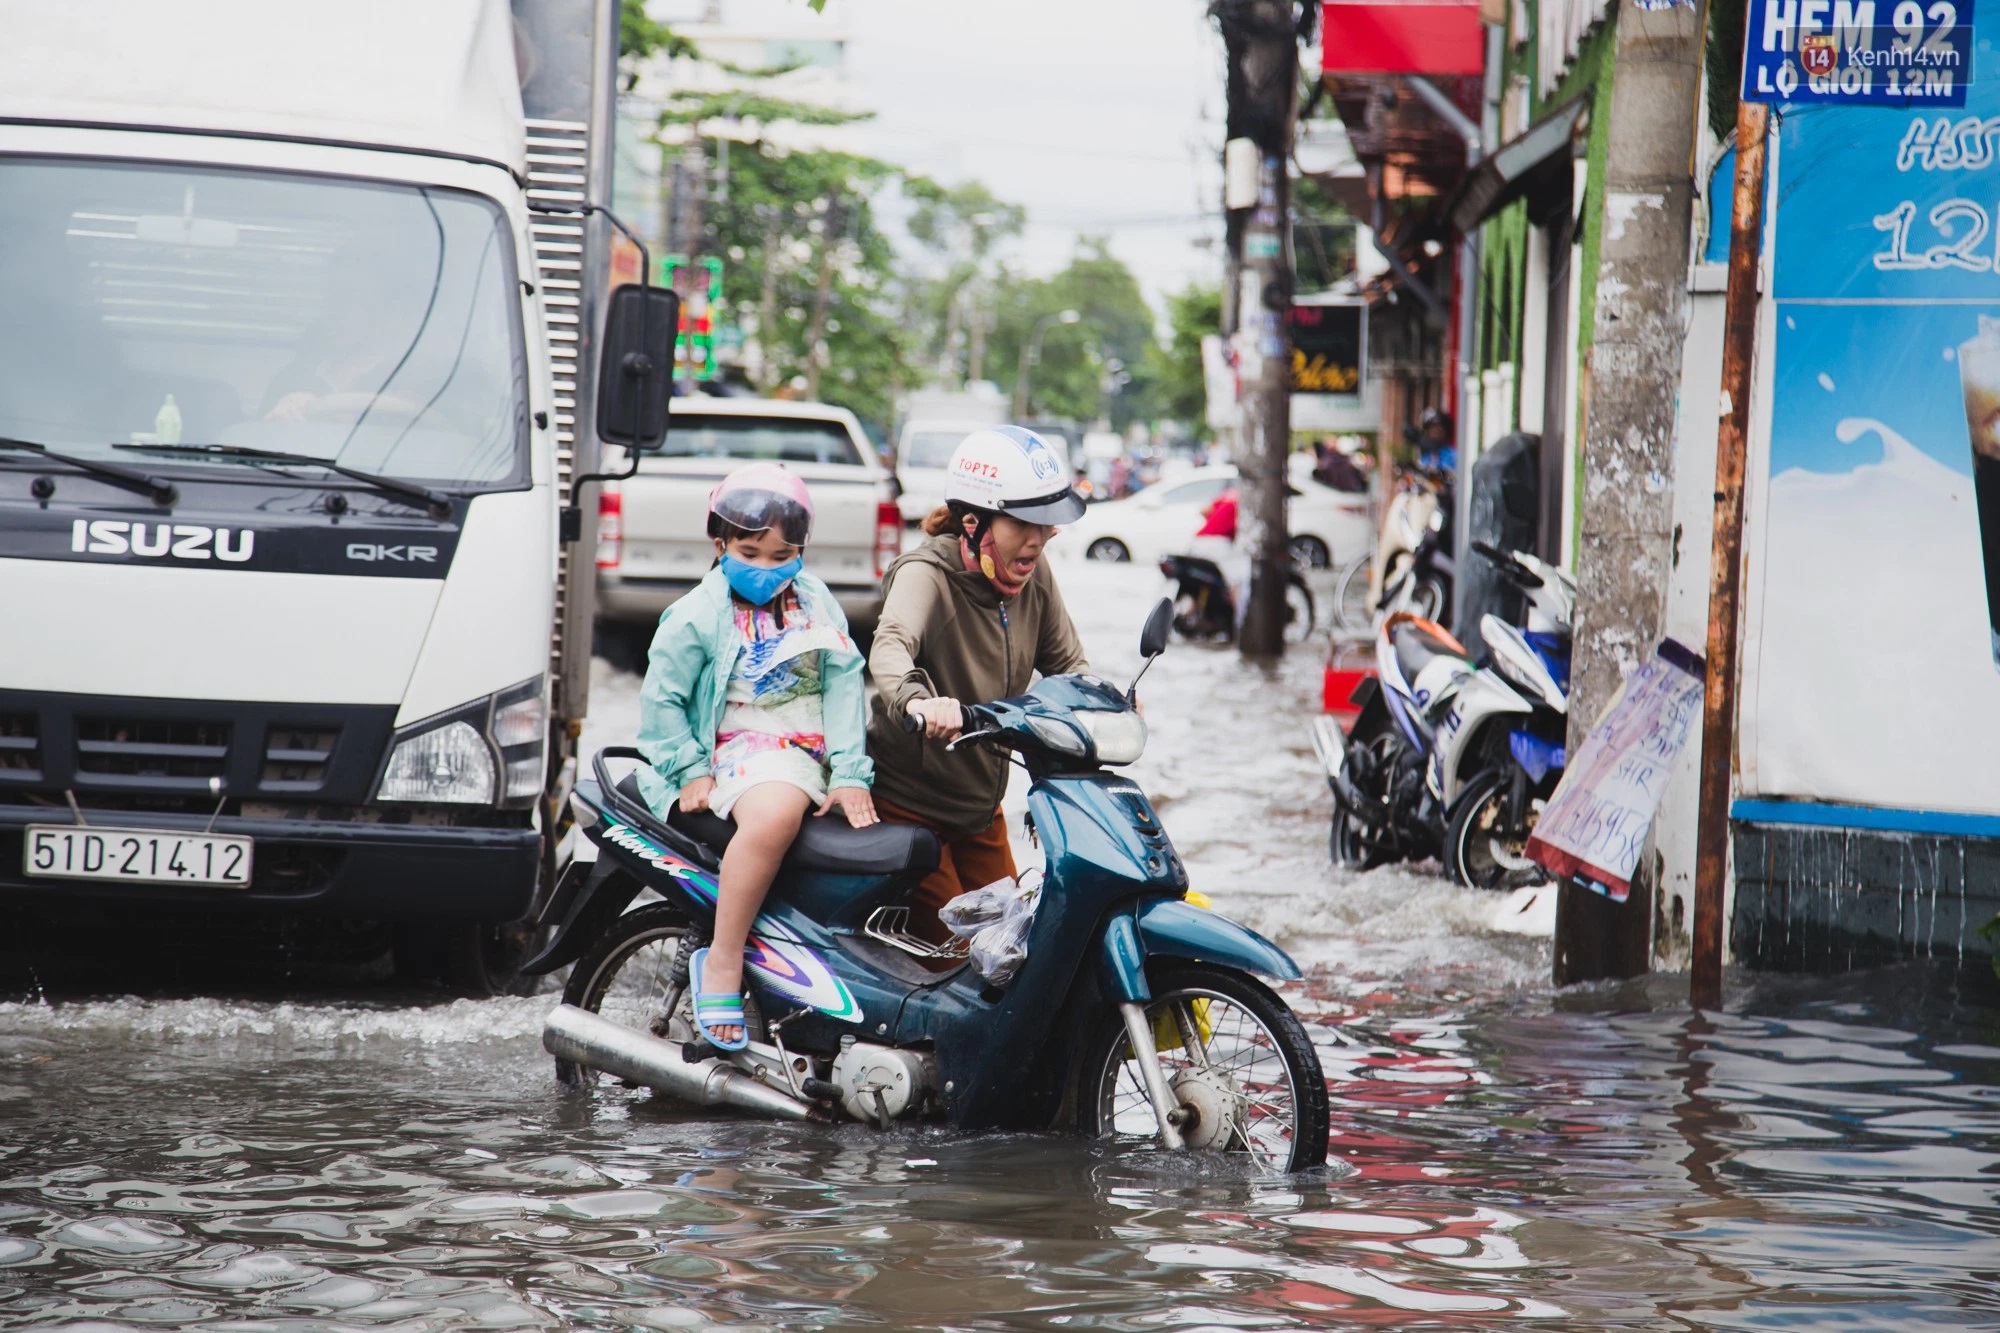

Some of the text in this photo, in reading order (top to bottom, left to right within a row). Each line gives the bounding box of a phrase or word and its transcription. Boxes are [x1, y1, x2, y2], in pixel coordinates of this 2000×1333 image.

[1892, 0, 1957, 55] 92
[1885, 67, 1953, 97] 12M
[72, 519, 255, 563] ISUZU
[346, 543, 438, 563] QKR
[33, 832, 244, 881] 51D-214.12
